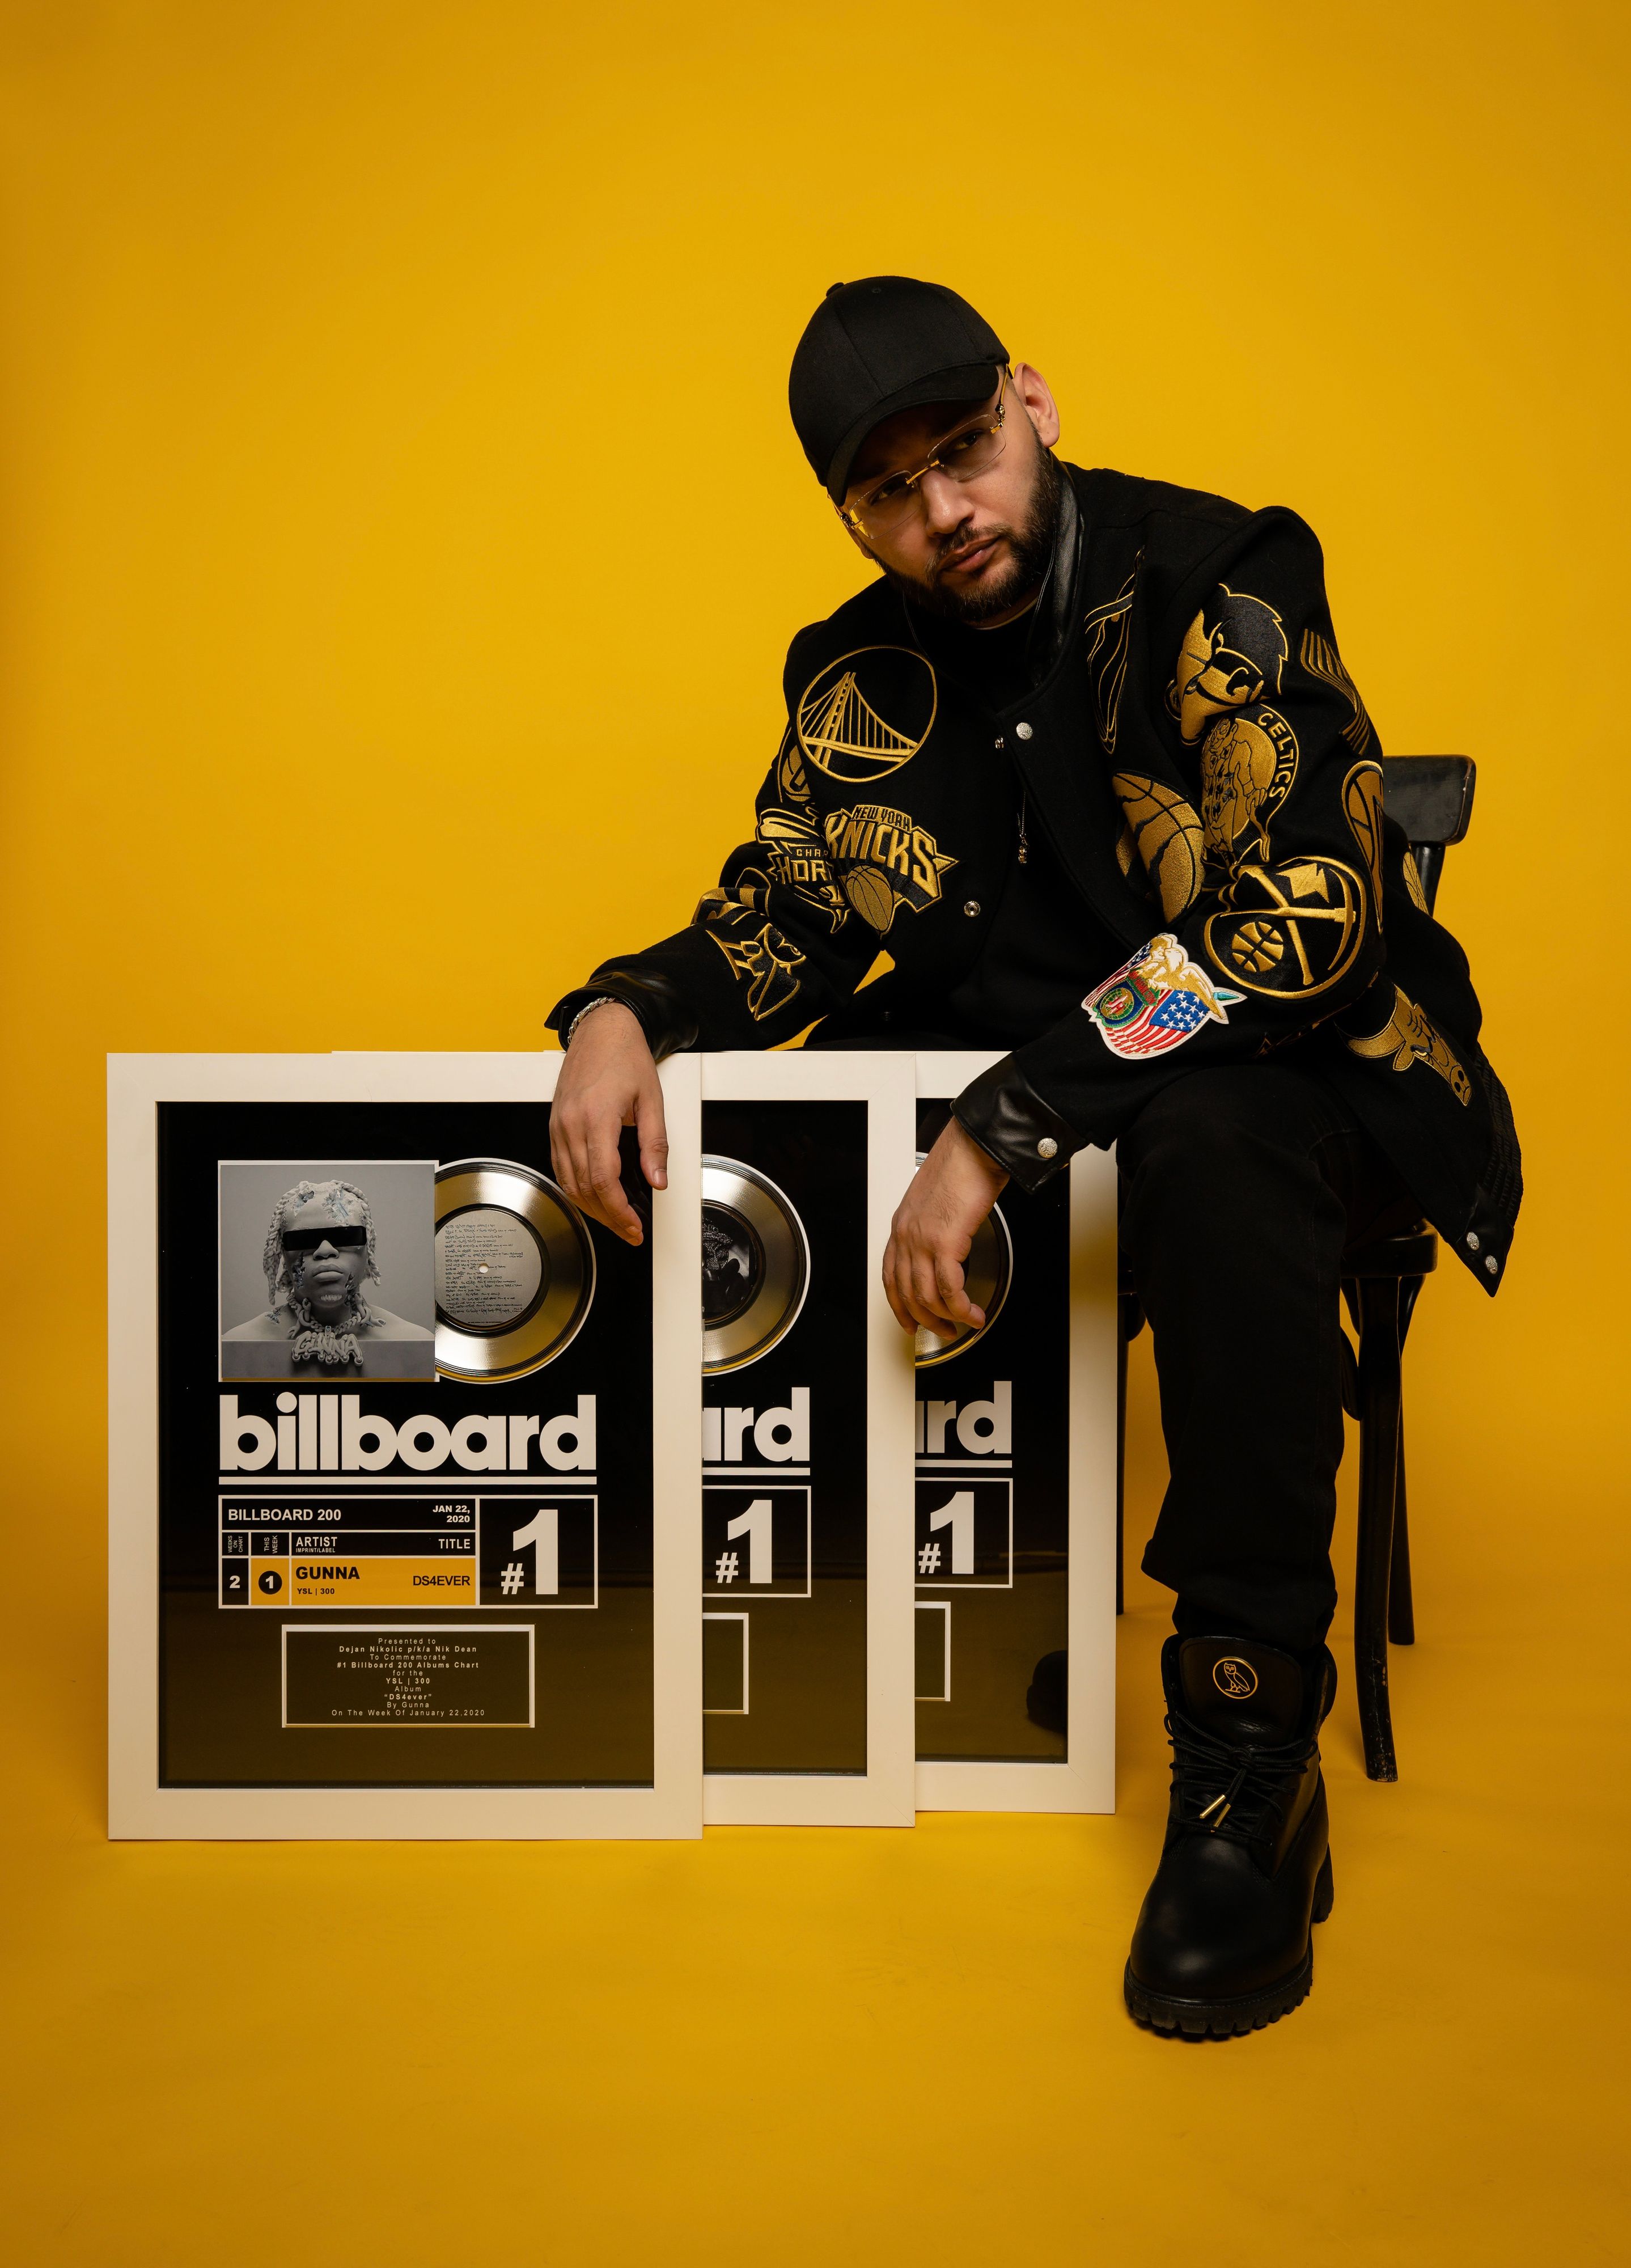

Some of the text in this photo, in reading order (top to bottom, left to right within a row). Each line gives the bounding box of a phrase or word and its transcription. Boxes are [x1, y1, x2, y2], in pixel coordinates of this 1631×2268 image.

[1257, 713, 1294, 798] CELTICS
[852, 807, 910, 832] NEW YORK
[825, 814, 937, 898] KNICKS
[775, 856, 832, 885] HOR
[291, 1331, 363, 1364] GUNNA
[219, 1391, 596, 1471] billboard
[915, 1381, 1012, 1454] rd
[228, 1509, 341, 1521] BILLBOARD 200
[455, 1505, 470, 1514] 22,
[296, 1537, 337, 1547] ARTIST
[438, 1539, 471, 1549] TITLE
[715, 1499, 772, 1584] #1
[918, 1491, 975, 1575] #1
[501, 1509, 558, 1595] #1
[229, 1575, 240, 1589] 2
[265, 1575, 274, 1589] 1
[295, 1566, 361, 1580] GUNNA
[413, 1575, 471, 1586] DS4EVER
